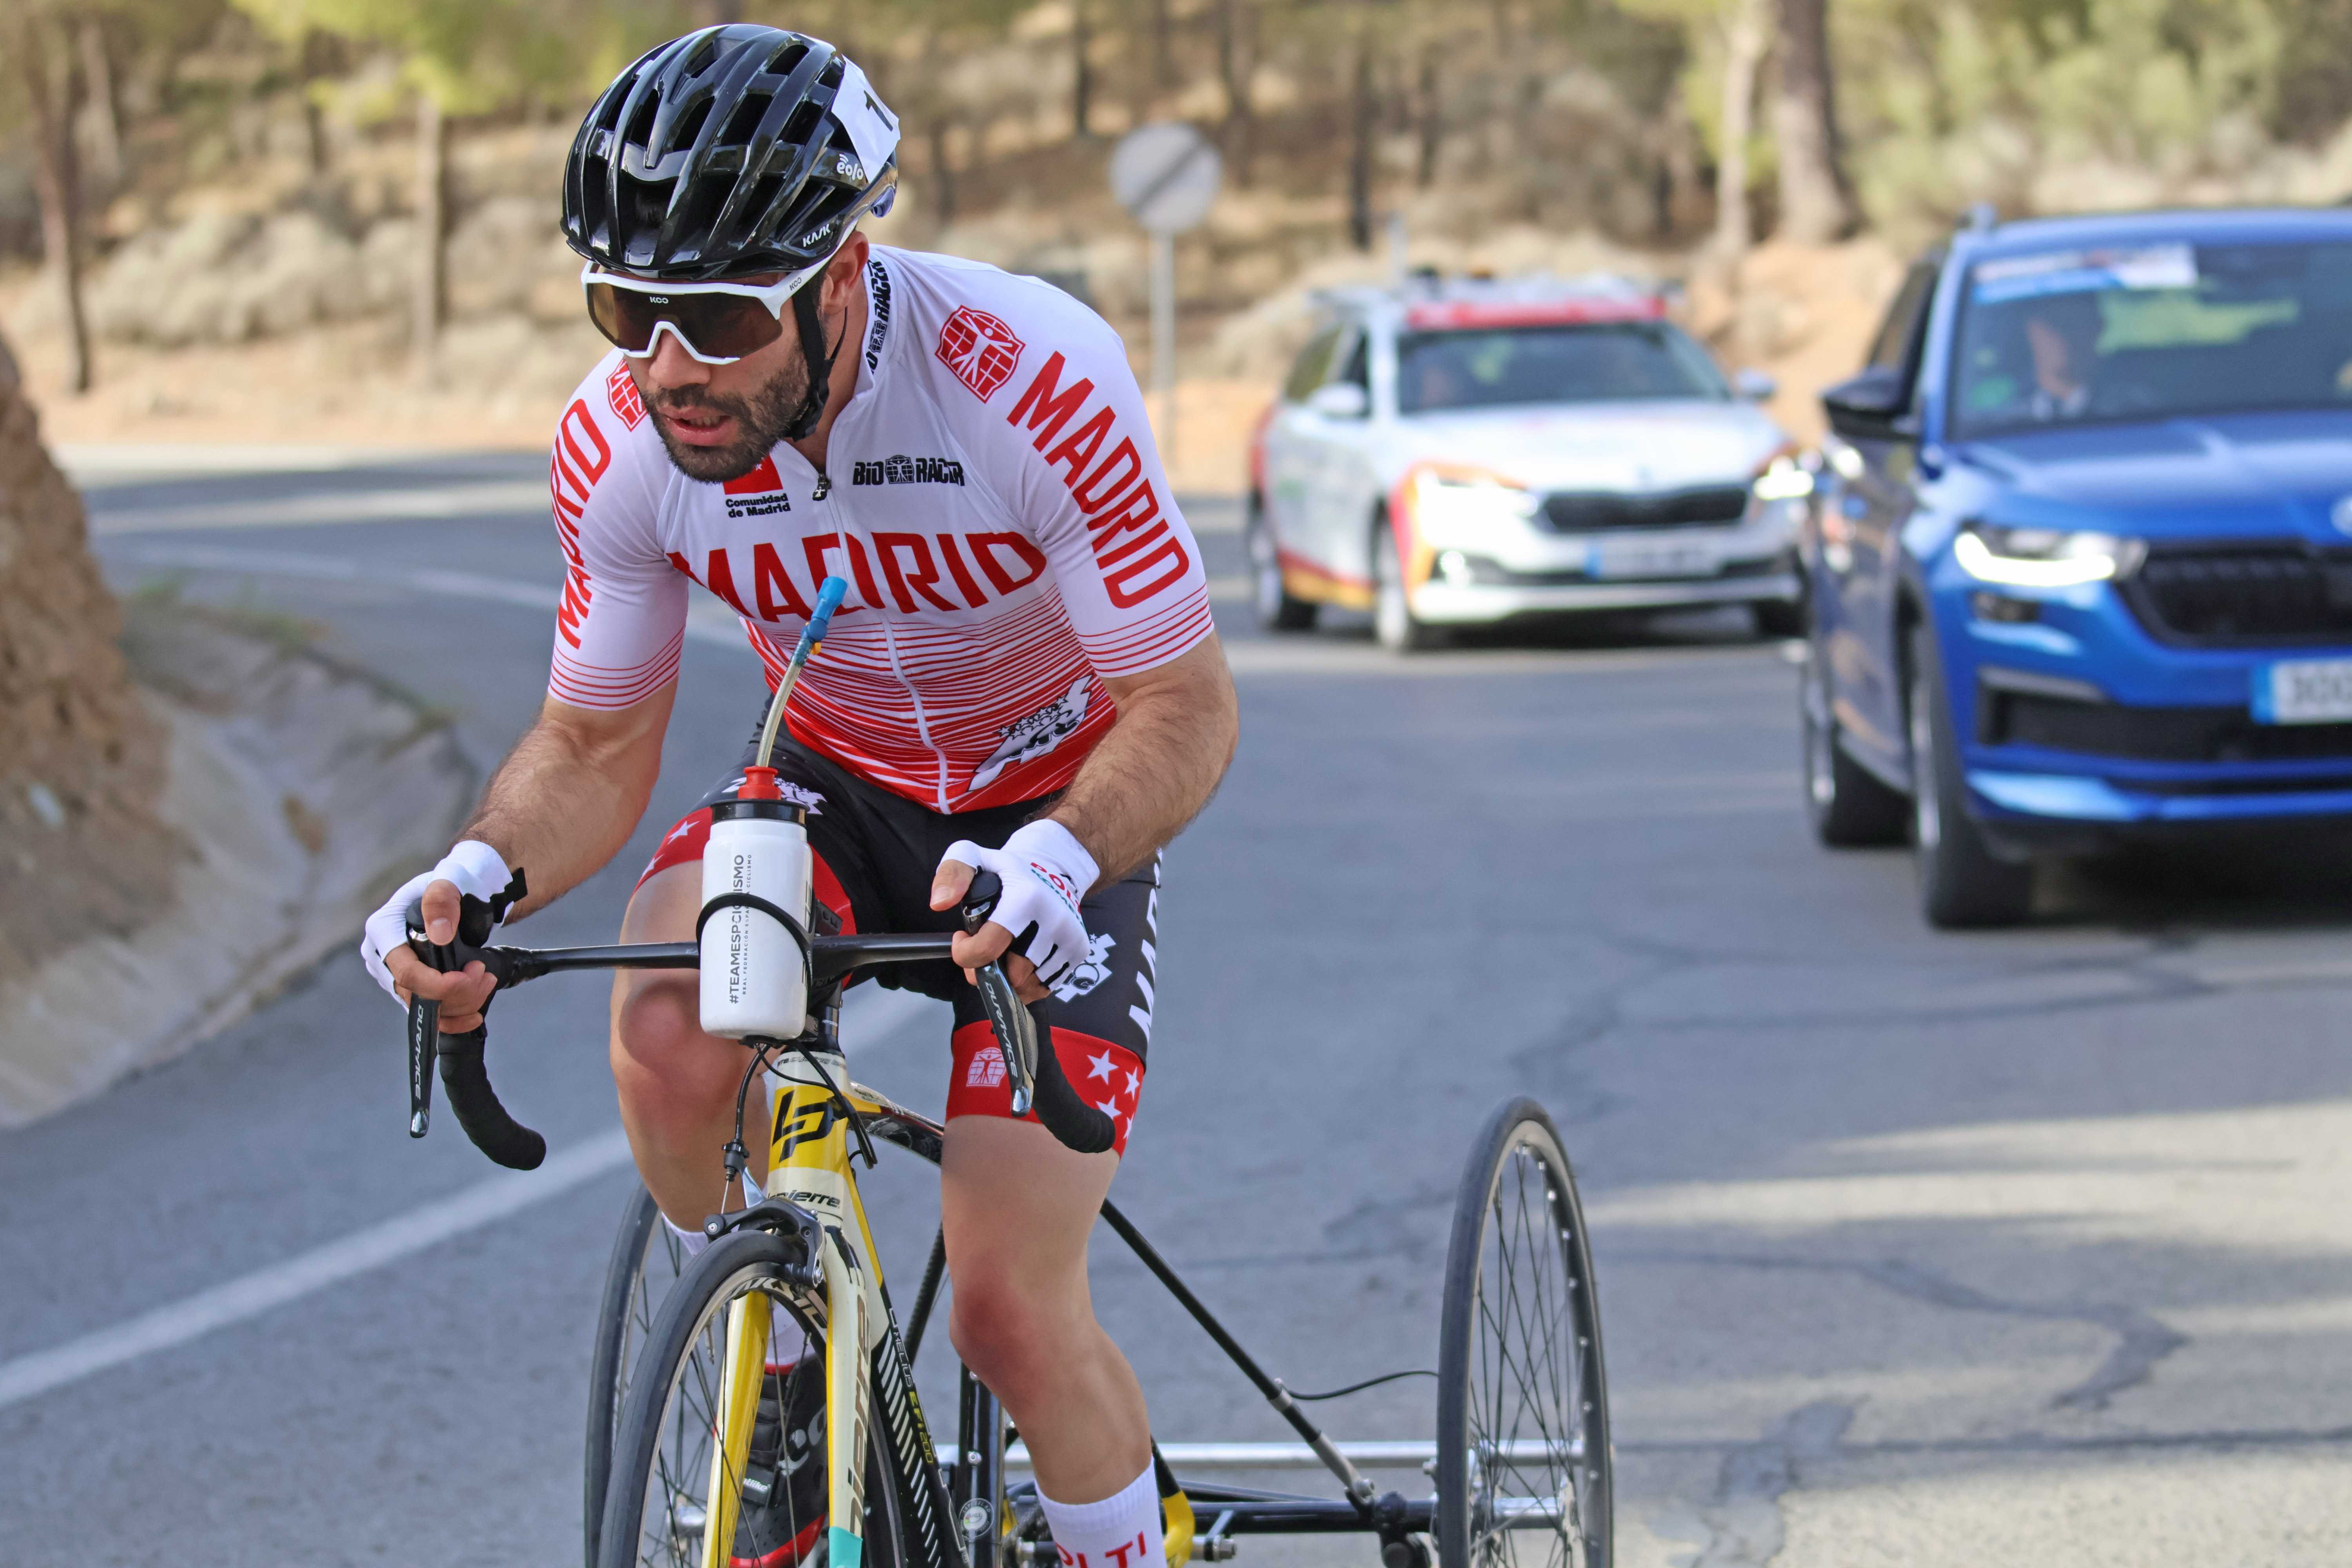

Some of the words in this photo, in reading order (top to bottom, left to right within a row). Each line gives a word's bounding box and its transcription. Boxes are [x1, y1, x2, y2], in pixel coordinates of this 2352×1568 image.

[864, 89, 893, 132] 1
[837, 161, 863, 180] eolo
[803, 223, 831, 247] KASK
[550, 398, 612, 650] MADRID
[726, 493, 788, 508] Comunidad
[728, 508, 743, 518] de
[746, 502, 791, 516] Madrid
[1006, 350, 1190, 609] MADRID
[665, 531, 1047, 623] MADRID
[729, 854, 744, 1004] #TEAMESPCICISMO
[415, 1004, 424, 1100] DURA-ACE
[984, 981, 1018, 1078] DURA-ACE
[767, 1190, 841, 1208] ierre
[893, 1331, 914, 1388] XELIUS
[920, 1431, 933, 1463] 200
